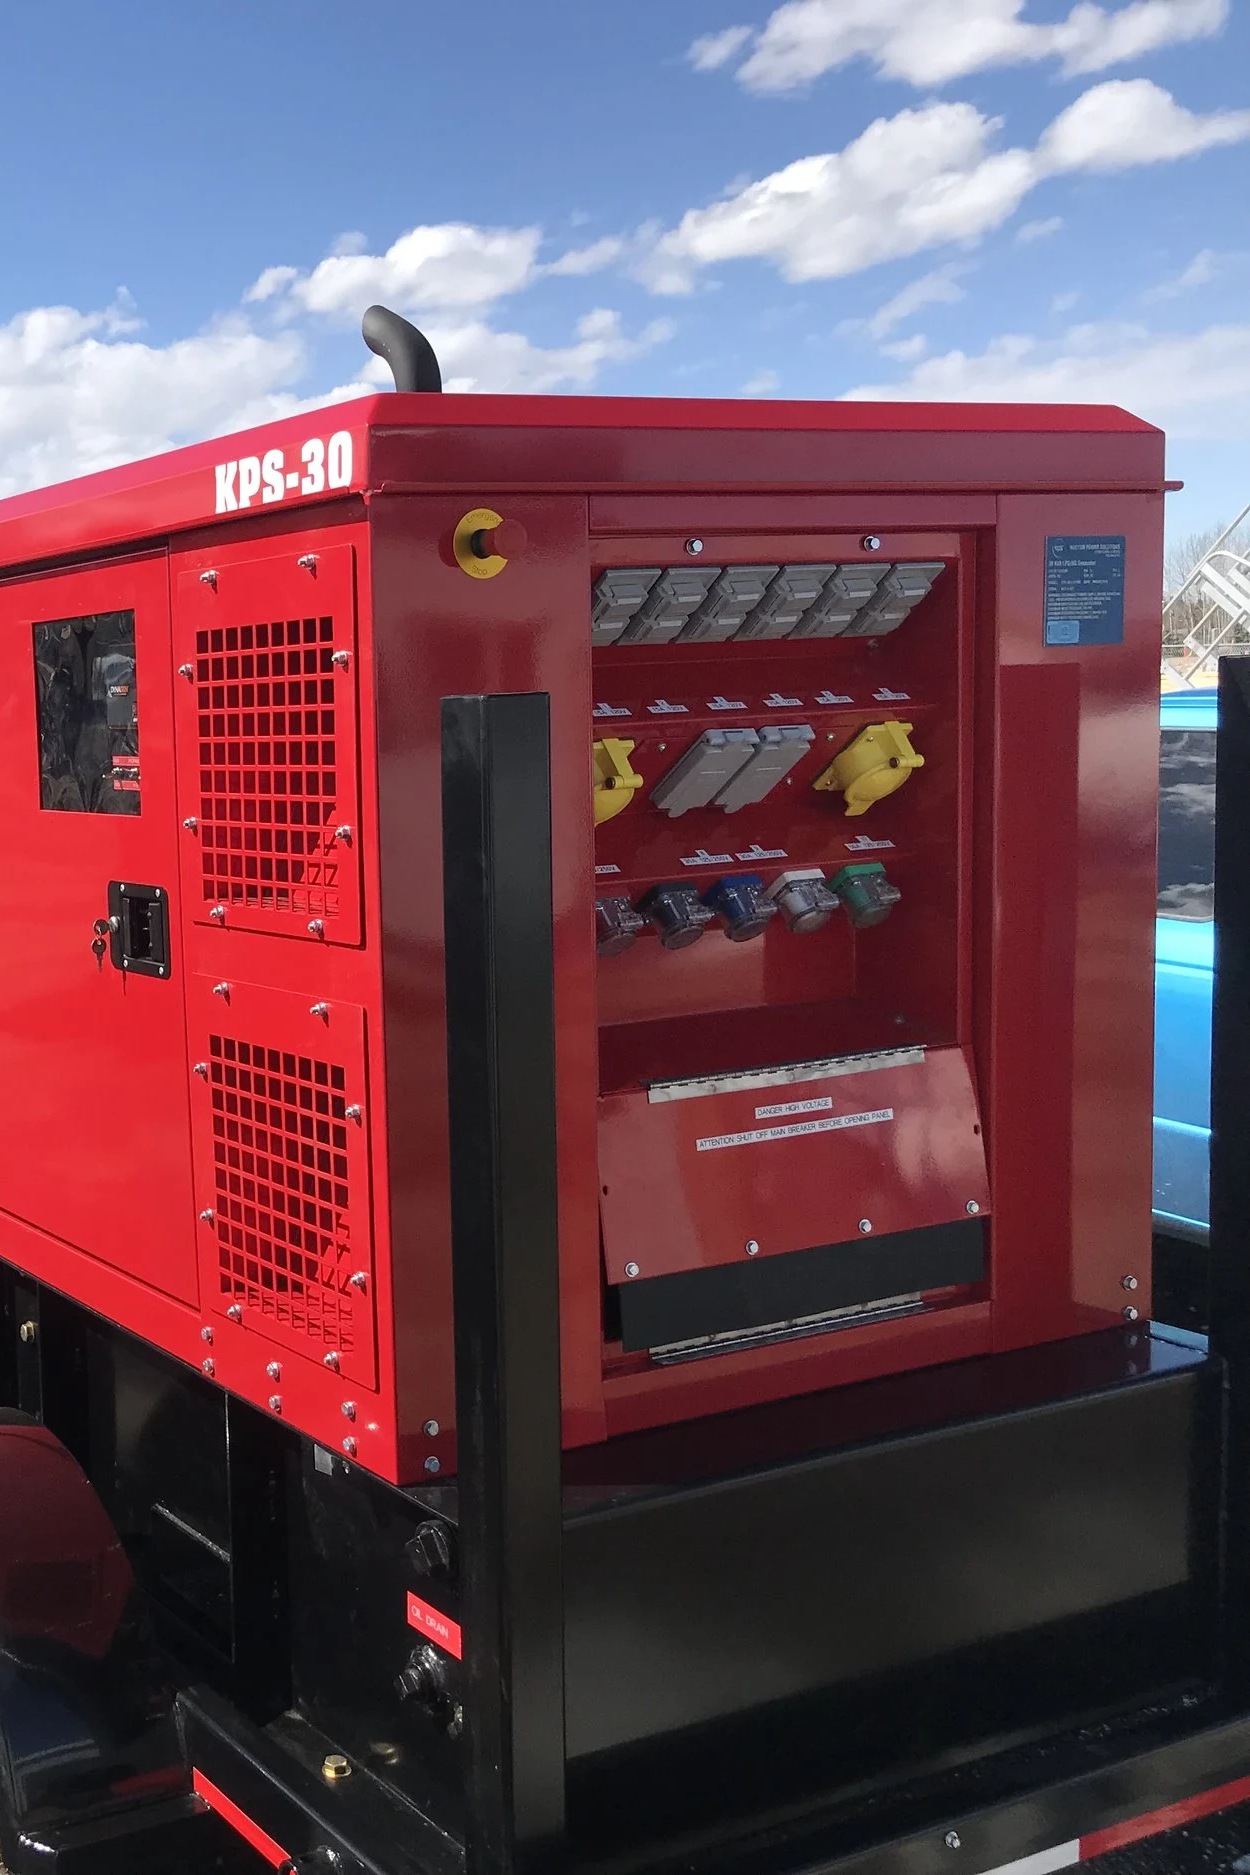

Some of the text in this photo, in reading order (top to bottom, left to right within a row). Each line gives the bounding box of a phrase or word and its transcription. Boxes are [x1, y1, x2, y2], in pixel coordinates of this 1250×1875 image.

[215, 430, 353, 514] KPS-30
[757, 1099, 830, 1117] DANGER HIGH VOLTAGE
[699, 1110, 891, 1148] ATTENTION SHUT OFF MAIN BREAKER BEFORE OPENING PANEL
[411, 1604, 449, 1640] OIL DRAIN
